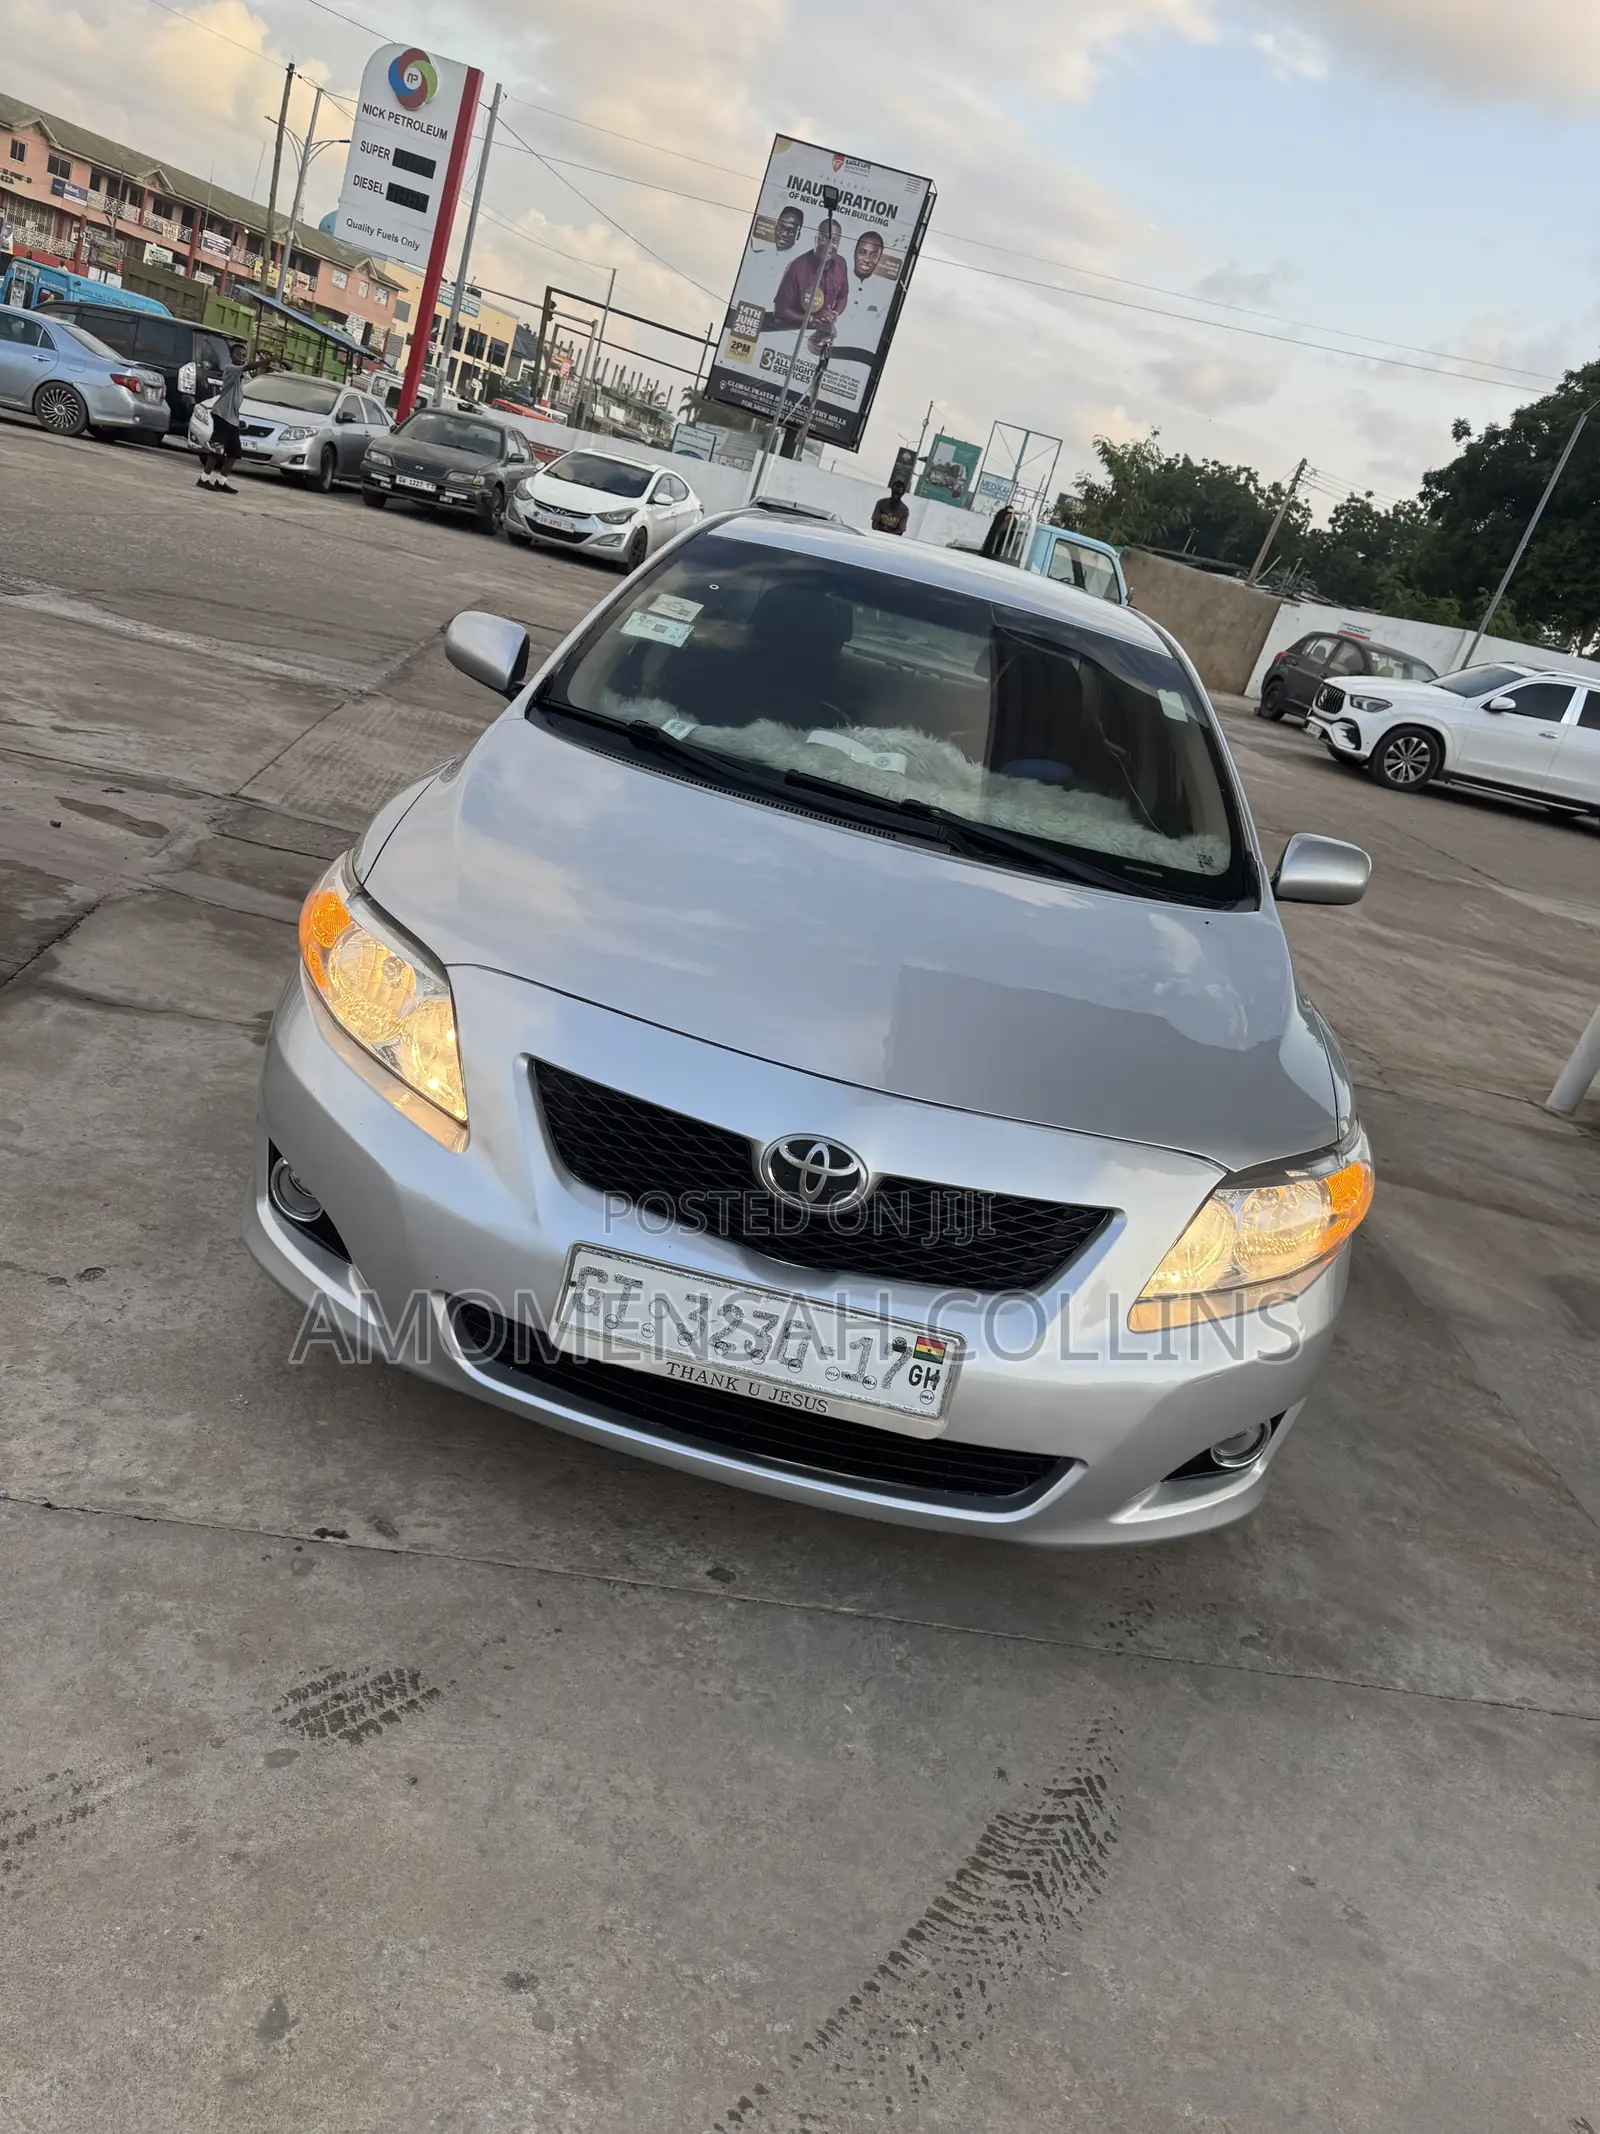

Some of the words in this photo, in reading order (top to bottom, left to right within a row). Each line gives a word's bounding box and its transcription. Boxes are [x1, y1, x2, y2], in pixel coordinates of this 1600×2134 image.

[362, 103, 386, 120] NICK
[387, 112, 448, 140] PETROLEUM
[360, 140, 391, 160] SUPER
[353, 174, 384, 195] DIESEL
[786, 174, 899, 219] INAURATION
[789, 191, 799, 200] OF
[800, 195, 818, 206] NEW
[819, 200, 851, 216] CRCH
[851, 211, 889, 227] BUILDING
[346, 218, 375, 236] Quality
[376, 228, 399, 243] Fuels
[401, 236, 420, 252] Only
[735, 315, 760, 328] JUNE
[739, 304, 762, 319] 14TH
[733, 324, 757, 337] 2026
[730, 340, 751, 353] 2PM
[762, 350, 774, 368] 3
[774, 359, 790, 370] ALL
[772, 367, 811, 384] SERICES
[572, 1265, 644, 1323] GT
[666, 1361, 743, 1391] THANK
[749, 1383, 762, 1396] U
[768, 1387, 829, 1414] JESUS
[908, 1364, 941, 1391] GH
